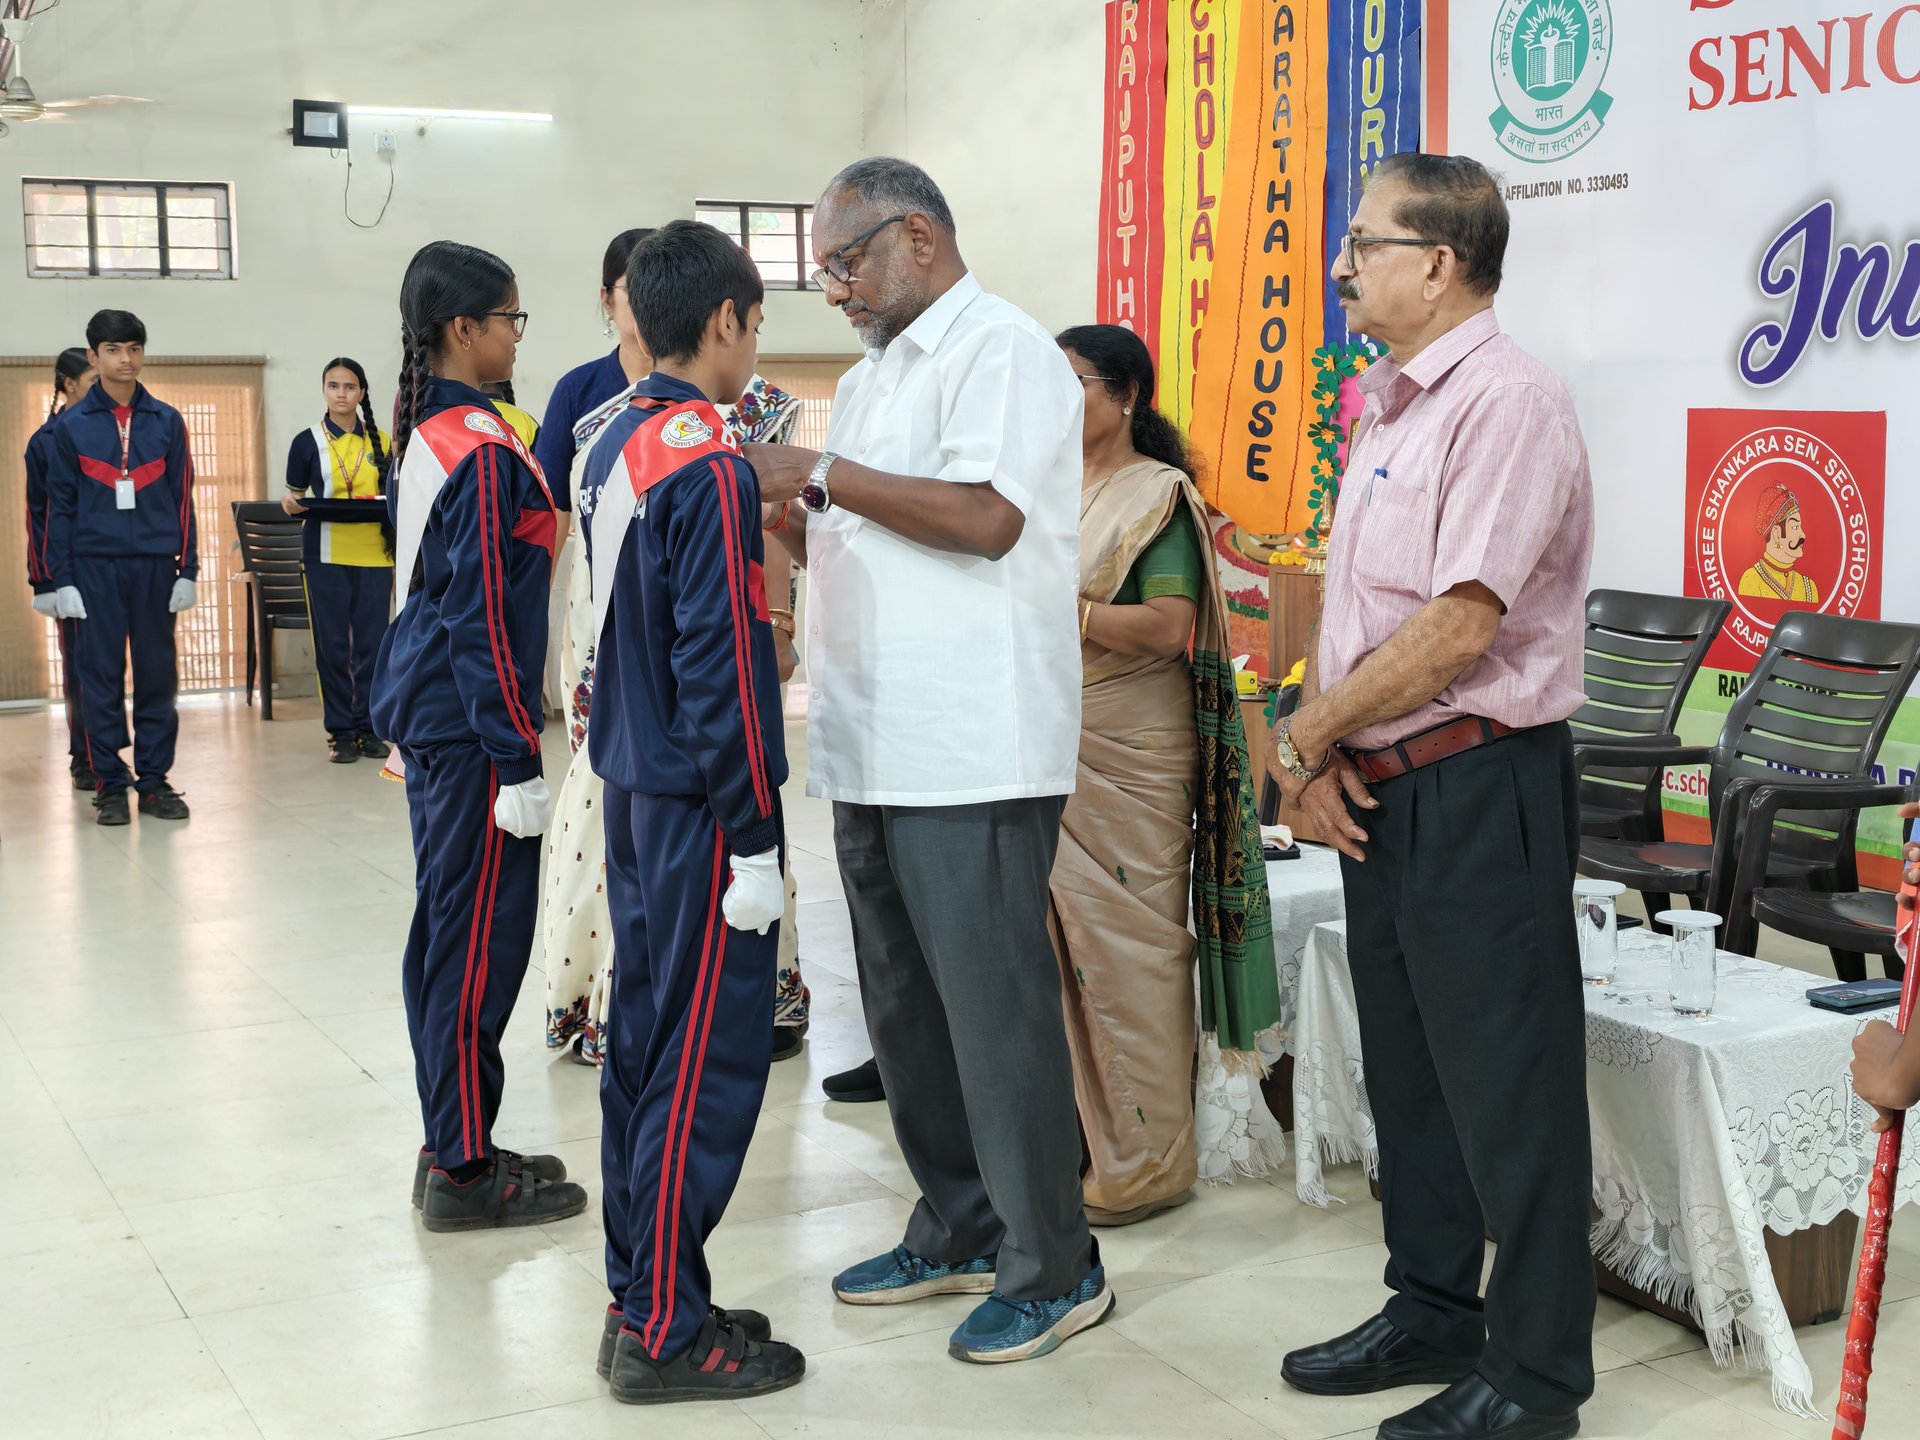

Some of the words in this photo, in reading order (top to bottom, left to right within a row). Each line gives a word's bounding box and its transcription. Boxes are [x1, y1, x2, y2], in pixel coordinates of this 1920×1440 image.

[1263, 0, 1294, 253] ARATHA
[1359, 0, 1385, 190] OUR
[1535, 105, 1563, 121] भारत
[1116, 2, 1137, 267] RAJPUT
[1507, 131, 1535, 153] असतो
[1505, 180, 1562, 201] AFFILIATION
[1567, 178, 1584, 194] NO.
[1587, 173, 1629, 192] 3330493
[1246, 275, 1290, 482] HOUSE
[1705, 435, 1780, 521] SHANKARA
[1783, 435, 1820, 465] SEN.
[1824, 458, 1855, 508] SEC.
[1702, 526, 1725, 600] SHREE
